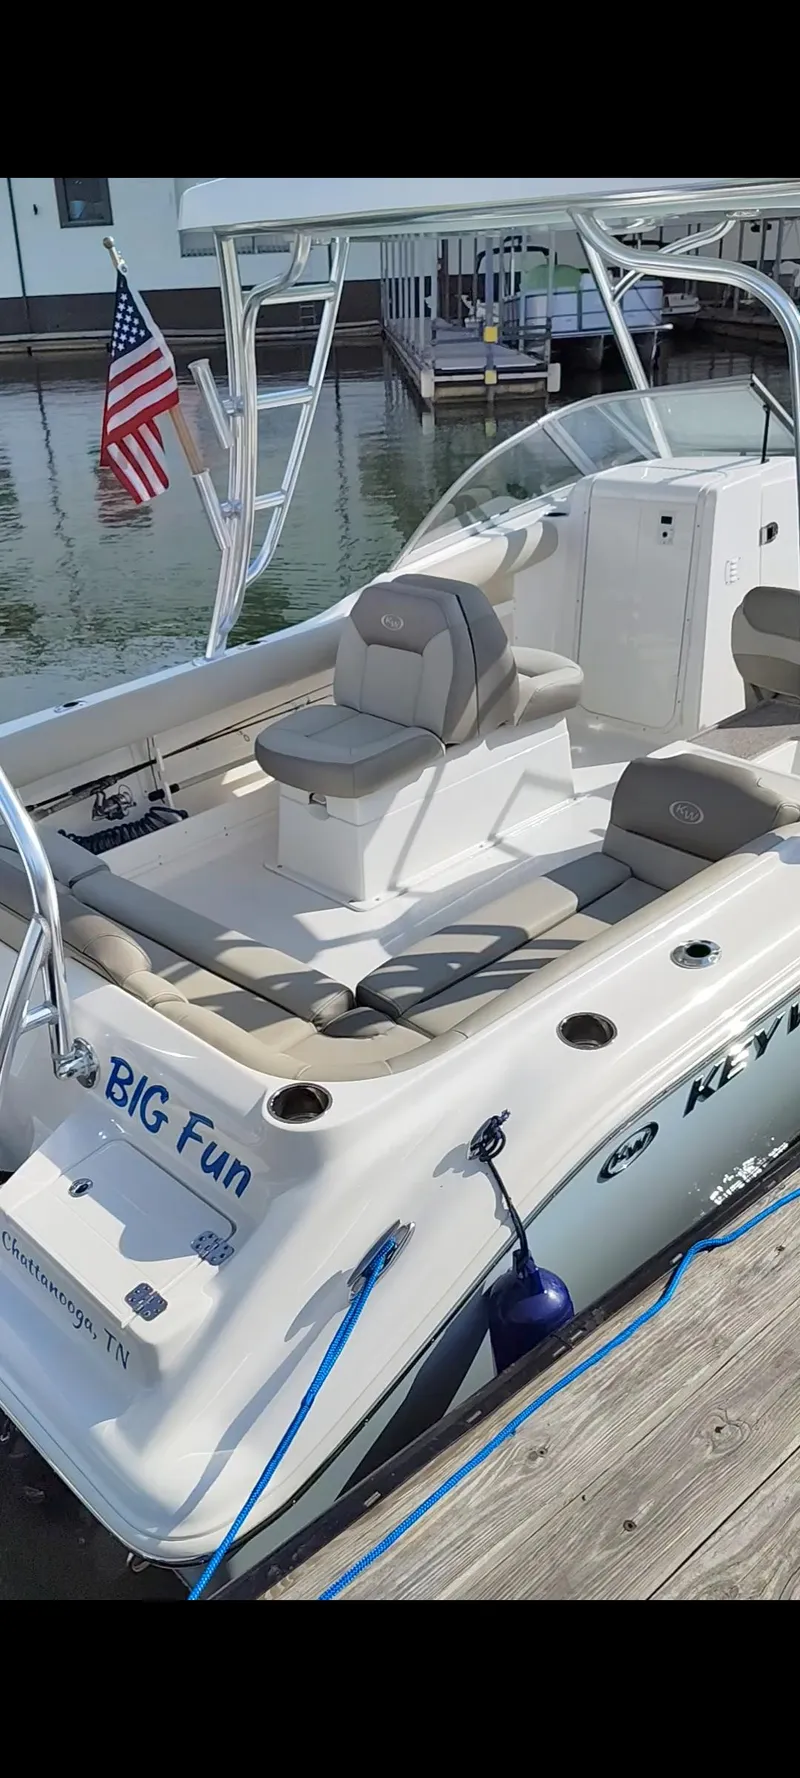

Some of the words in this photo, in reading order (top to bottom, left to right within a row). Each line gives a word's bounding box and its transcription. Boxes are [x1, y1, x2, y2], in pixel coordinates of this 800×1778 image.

[675, 803, 700, 821] KW
[105, 1056, 170, 1134] BIG
[176, 1110, 252, 1198] Fun
[1, 1231, 97, 1340] Chattanooga,
[104, 1329, 131, 1370] TN
